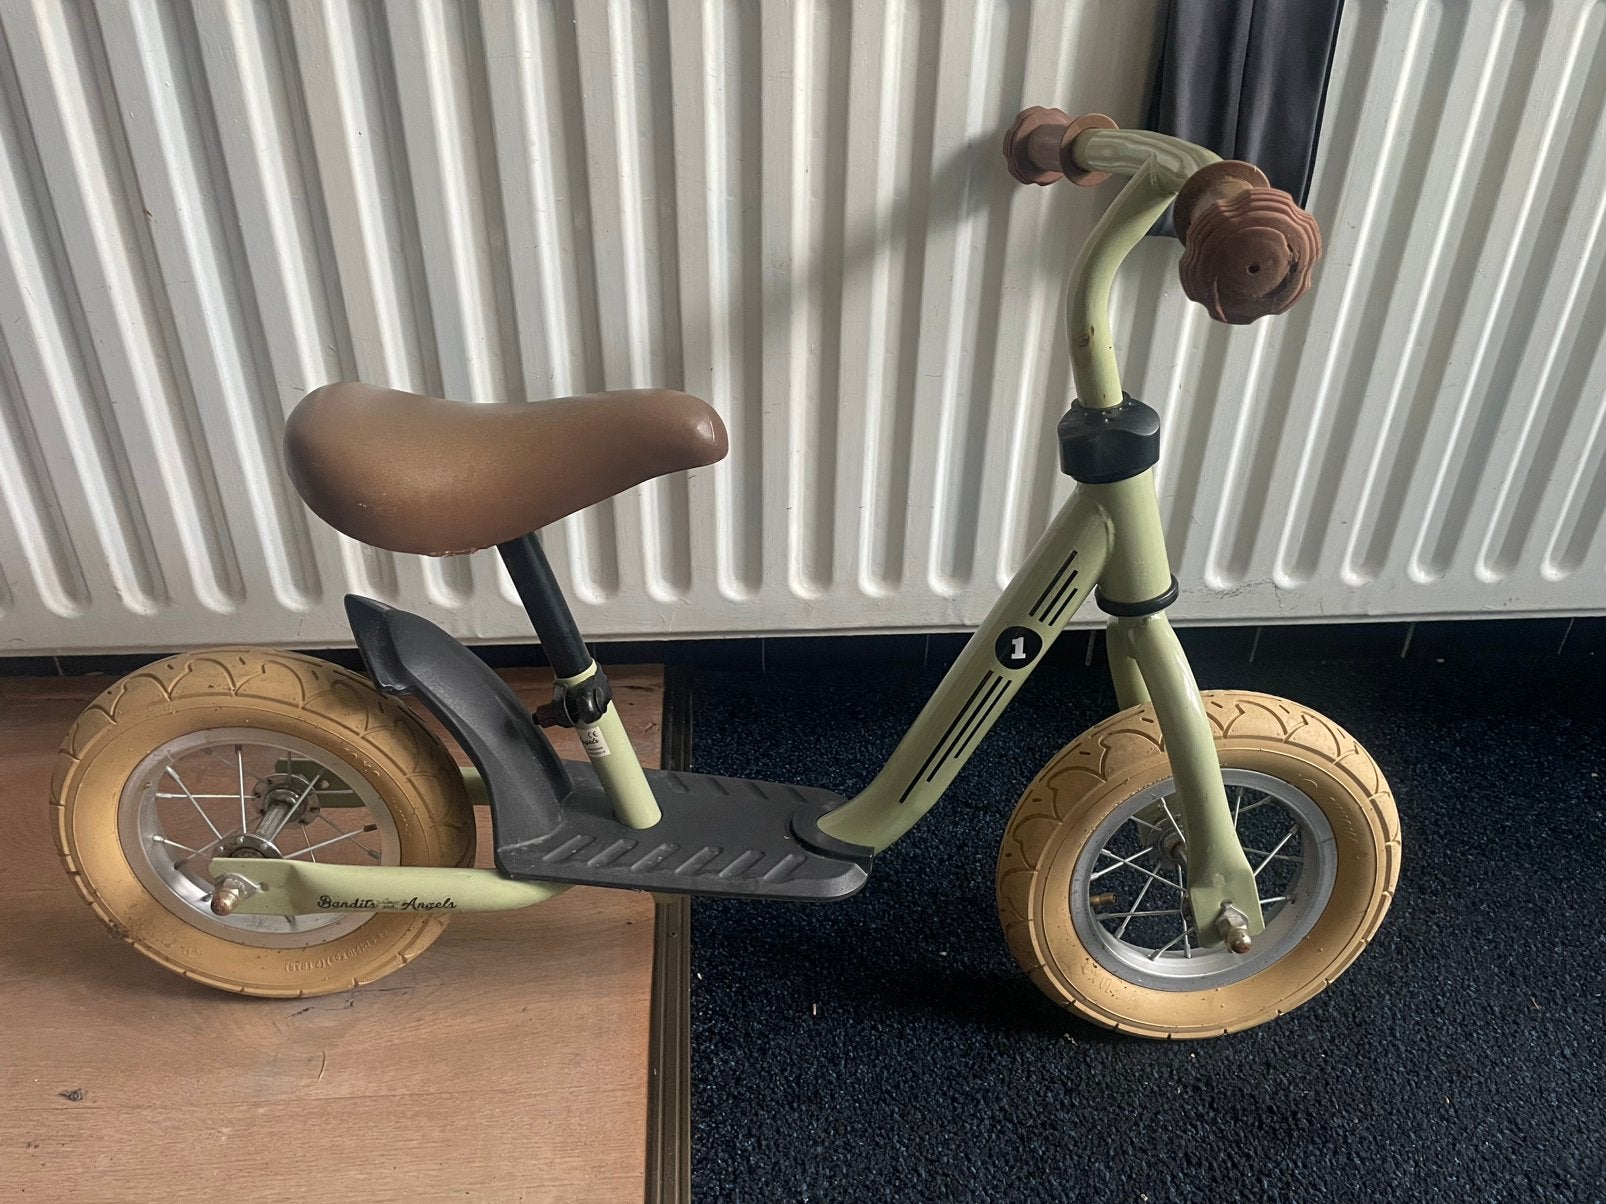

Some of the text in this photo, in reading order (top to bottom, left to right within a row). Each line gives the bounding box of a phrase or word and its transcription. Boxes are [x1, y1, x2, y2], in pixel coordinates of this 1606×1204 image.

[1011, 636, 1026, 660] 1
[317, 895, 377, 909] Bandits
[401, 896, 457, 911] Angels
